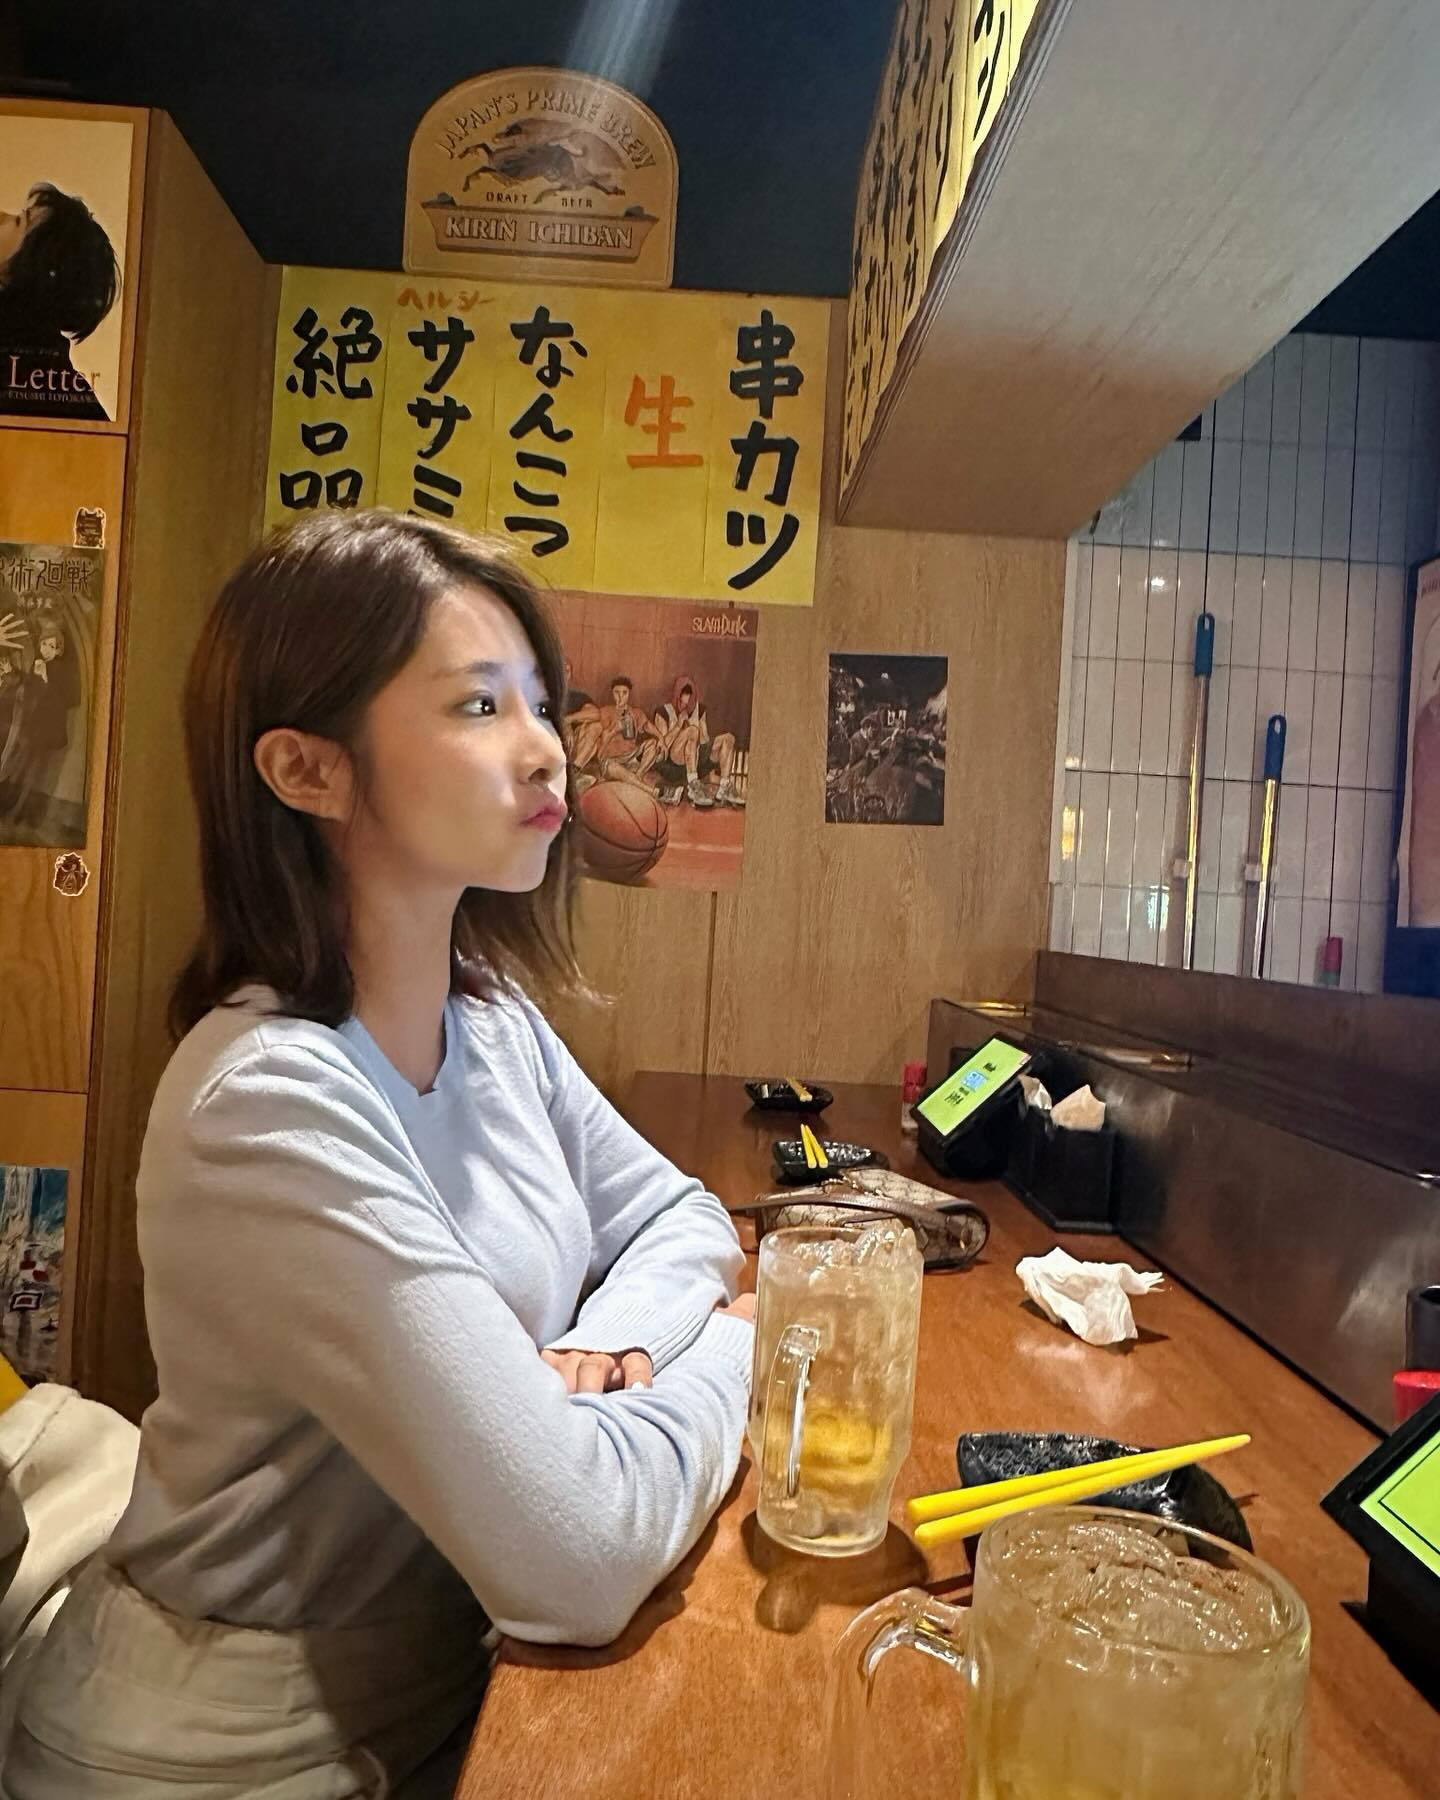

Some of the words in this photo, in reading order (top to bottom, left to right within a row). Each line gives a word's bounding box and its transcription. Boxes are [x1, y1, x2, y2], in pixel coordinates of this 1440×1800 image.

[446, 215, 518, 242] KIRIN
[528, 219, 633, 249] ICHIBAN
[8, 354, 101, 393] Letter
[279, 306, 384, 510] 絶品
[406, 316, 476, 518] ササミ
[504, 305, 588, 558] なんこつ
[624, 374, 704, 469] 生
[726, 309, 804, 590] 串カツ
